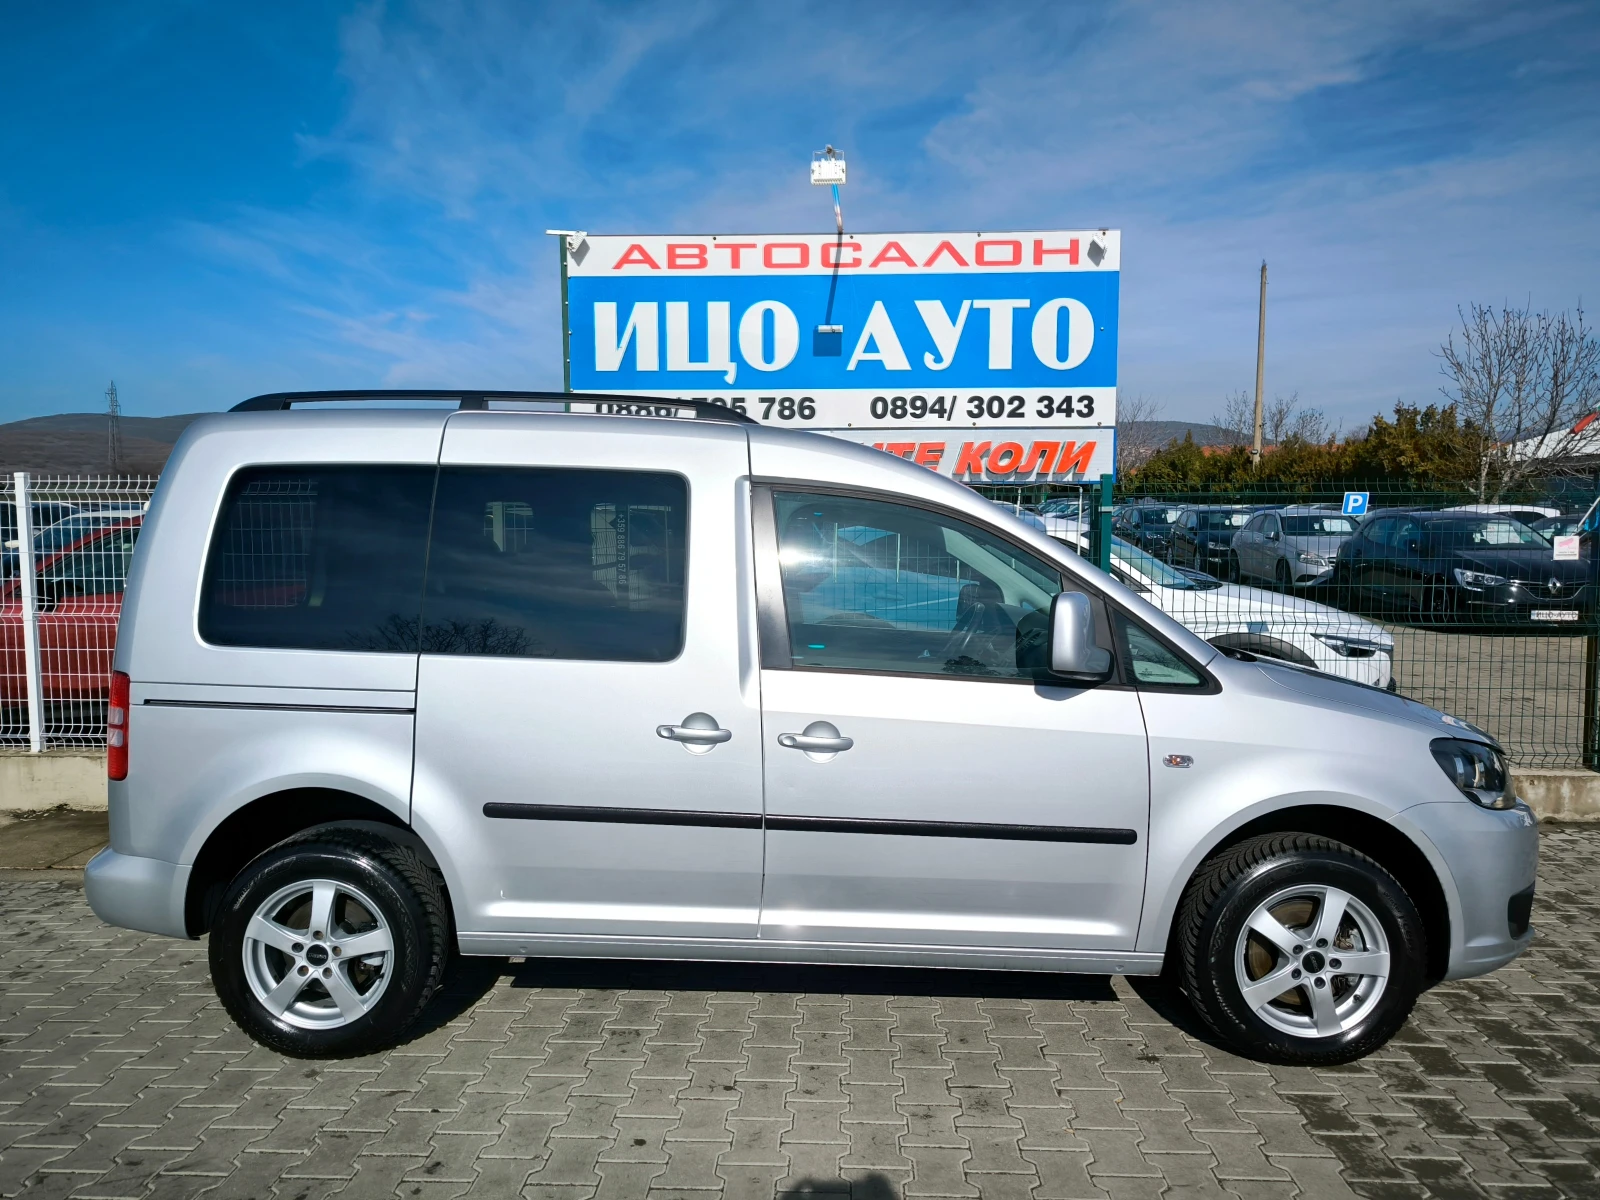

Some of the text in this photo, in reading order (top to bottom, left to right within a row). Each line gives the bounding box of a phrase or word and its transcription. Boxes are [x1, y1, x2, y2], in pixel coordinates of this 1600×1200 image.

[611, 238, 1080, 270] АВТОСАЛОН
[593, 297, 1095, 385] ИЦО АУТО
[758, 396, 816, 421] 786
[869, 395, 1096, 422] 0894/ 302 343
[954, 440, 1097, 476] КОЛИ
[1346, 494, 1363, 513] P
[617, 514, 626, 532] +359
[617, 552, 626, 561] 79
[617, 563, 627, 573] 57
